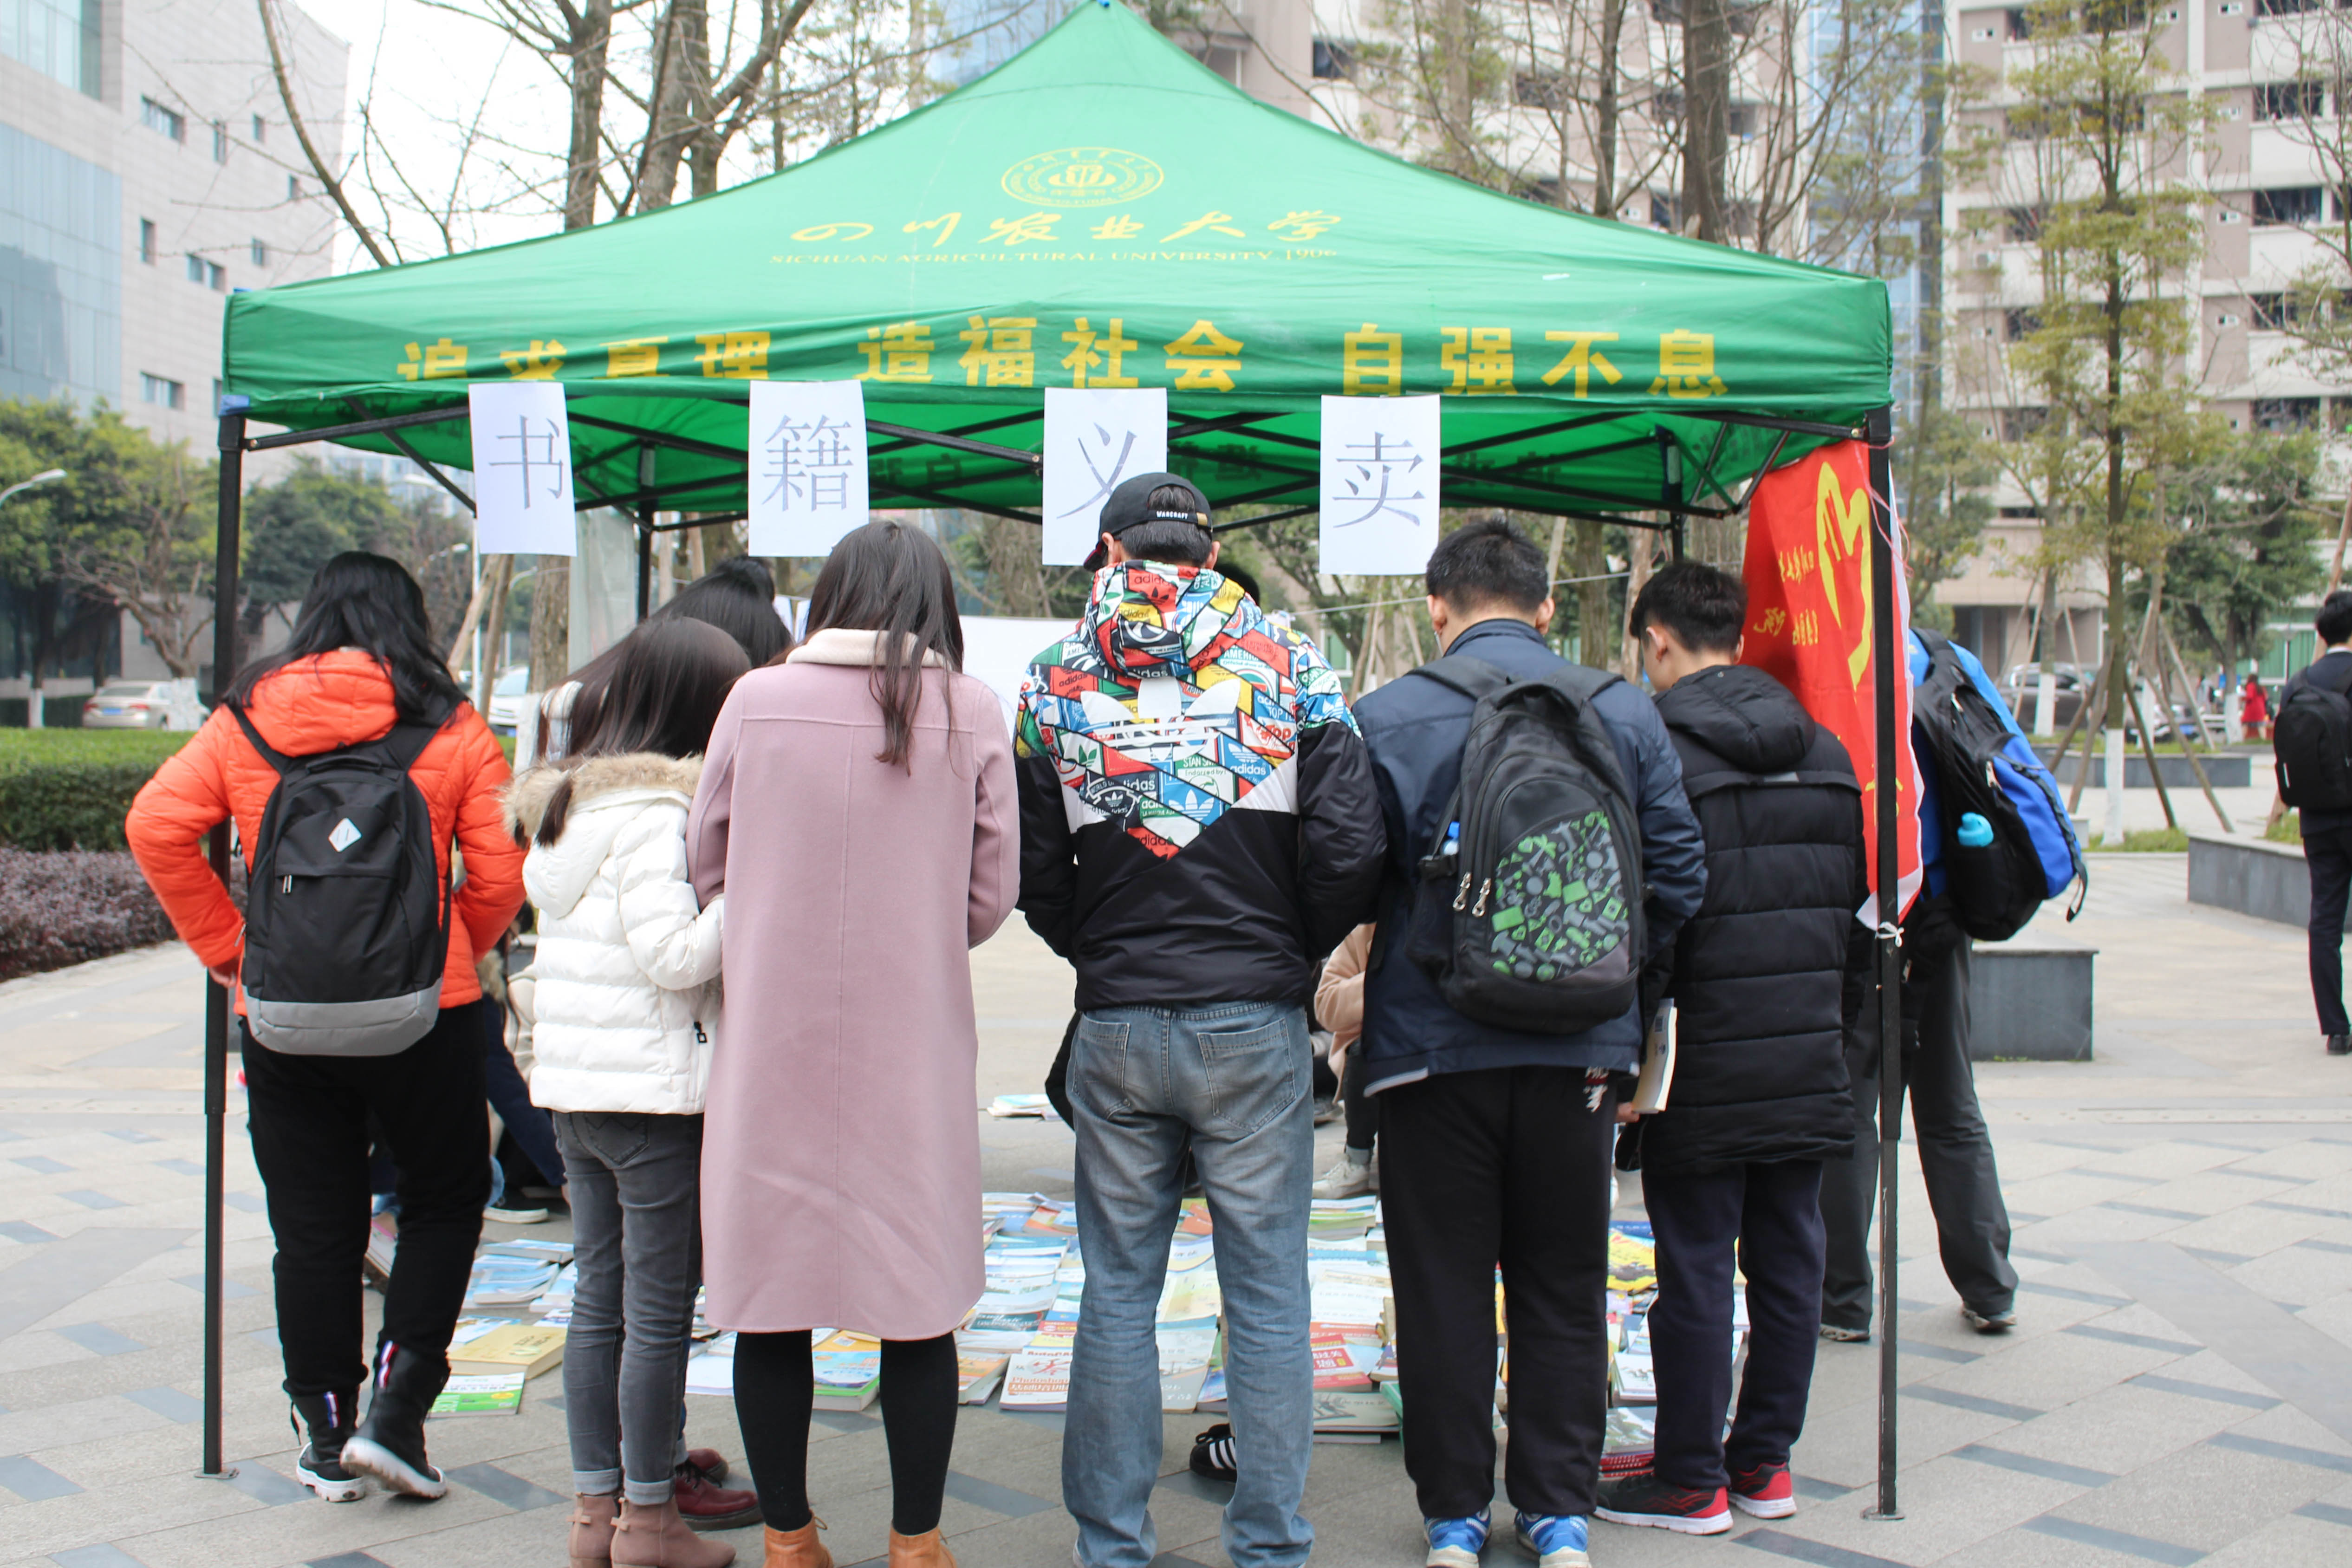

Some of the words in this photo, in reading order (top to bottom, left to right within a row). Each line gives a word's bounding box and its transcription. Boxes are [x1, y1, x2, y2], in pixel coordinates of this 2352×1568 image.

[769, 254, 889, 263] SICHUAN
[895, 252, 1102, 263] AGRICULTURAL
[1111, 251, 1273, 261] UNIVERSITY
[790, 210, 1341, 248] 四川农业大学
[397, 331, 772, 381] 追求真理
[852, 314, 1245, 393] 造福社会
[1343, 323, 1728, 399] 自强不息
[489, 415, 564, 510] 书
[761, 415, 854, 512] 籍
[1056, 422, 1137, 520] 义
[1333, 431, 1425, 529] 卖
